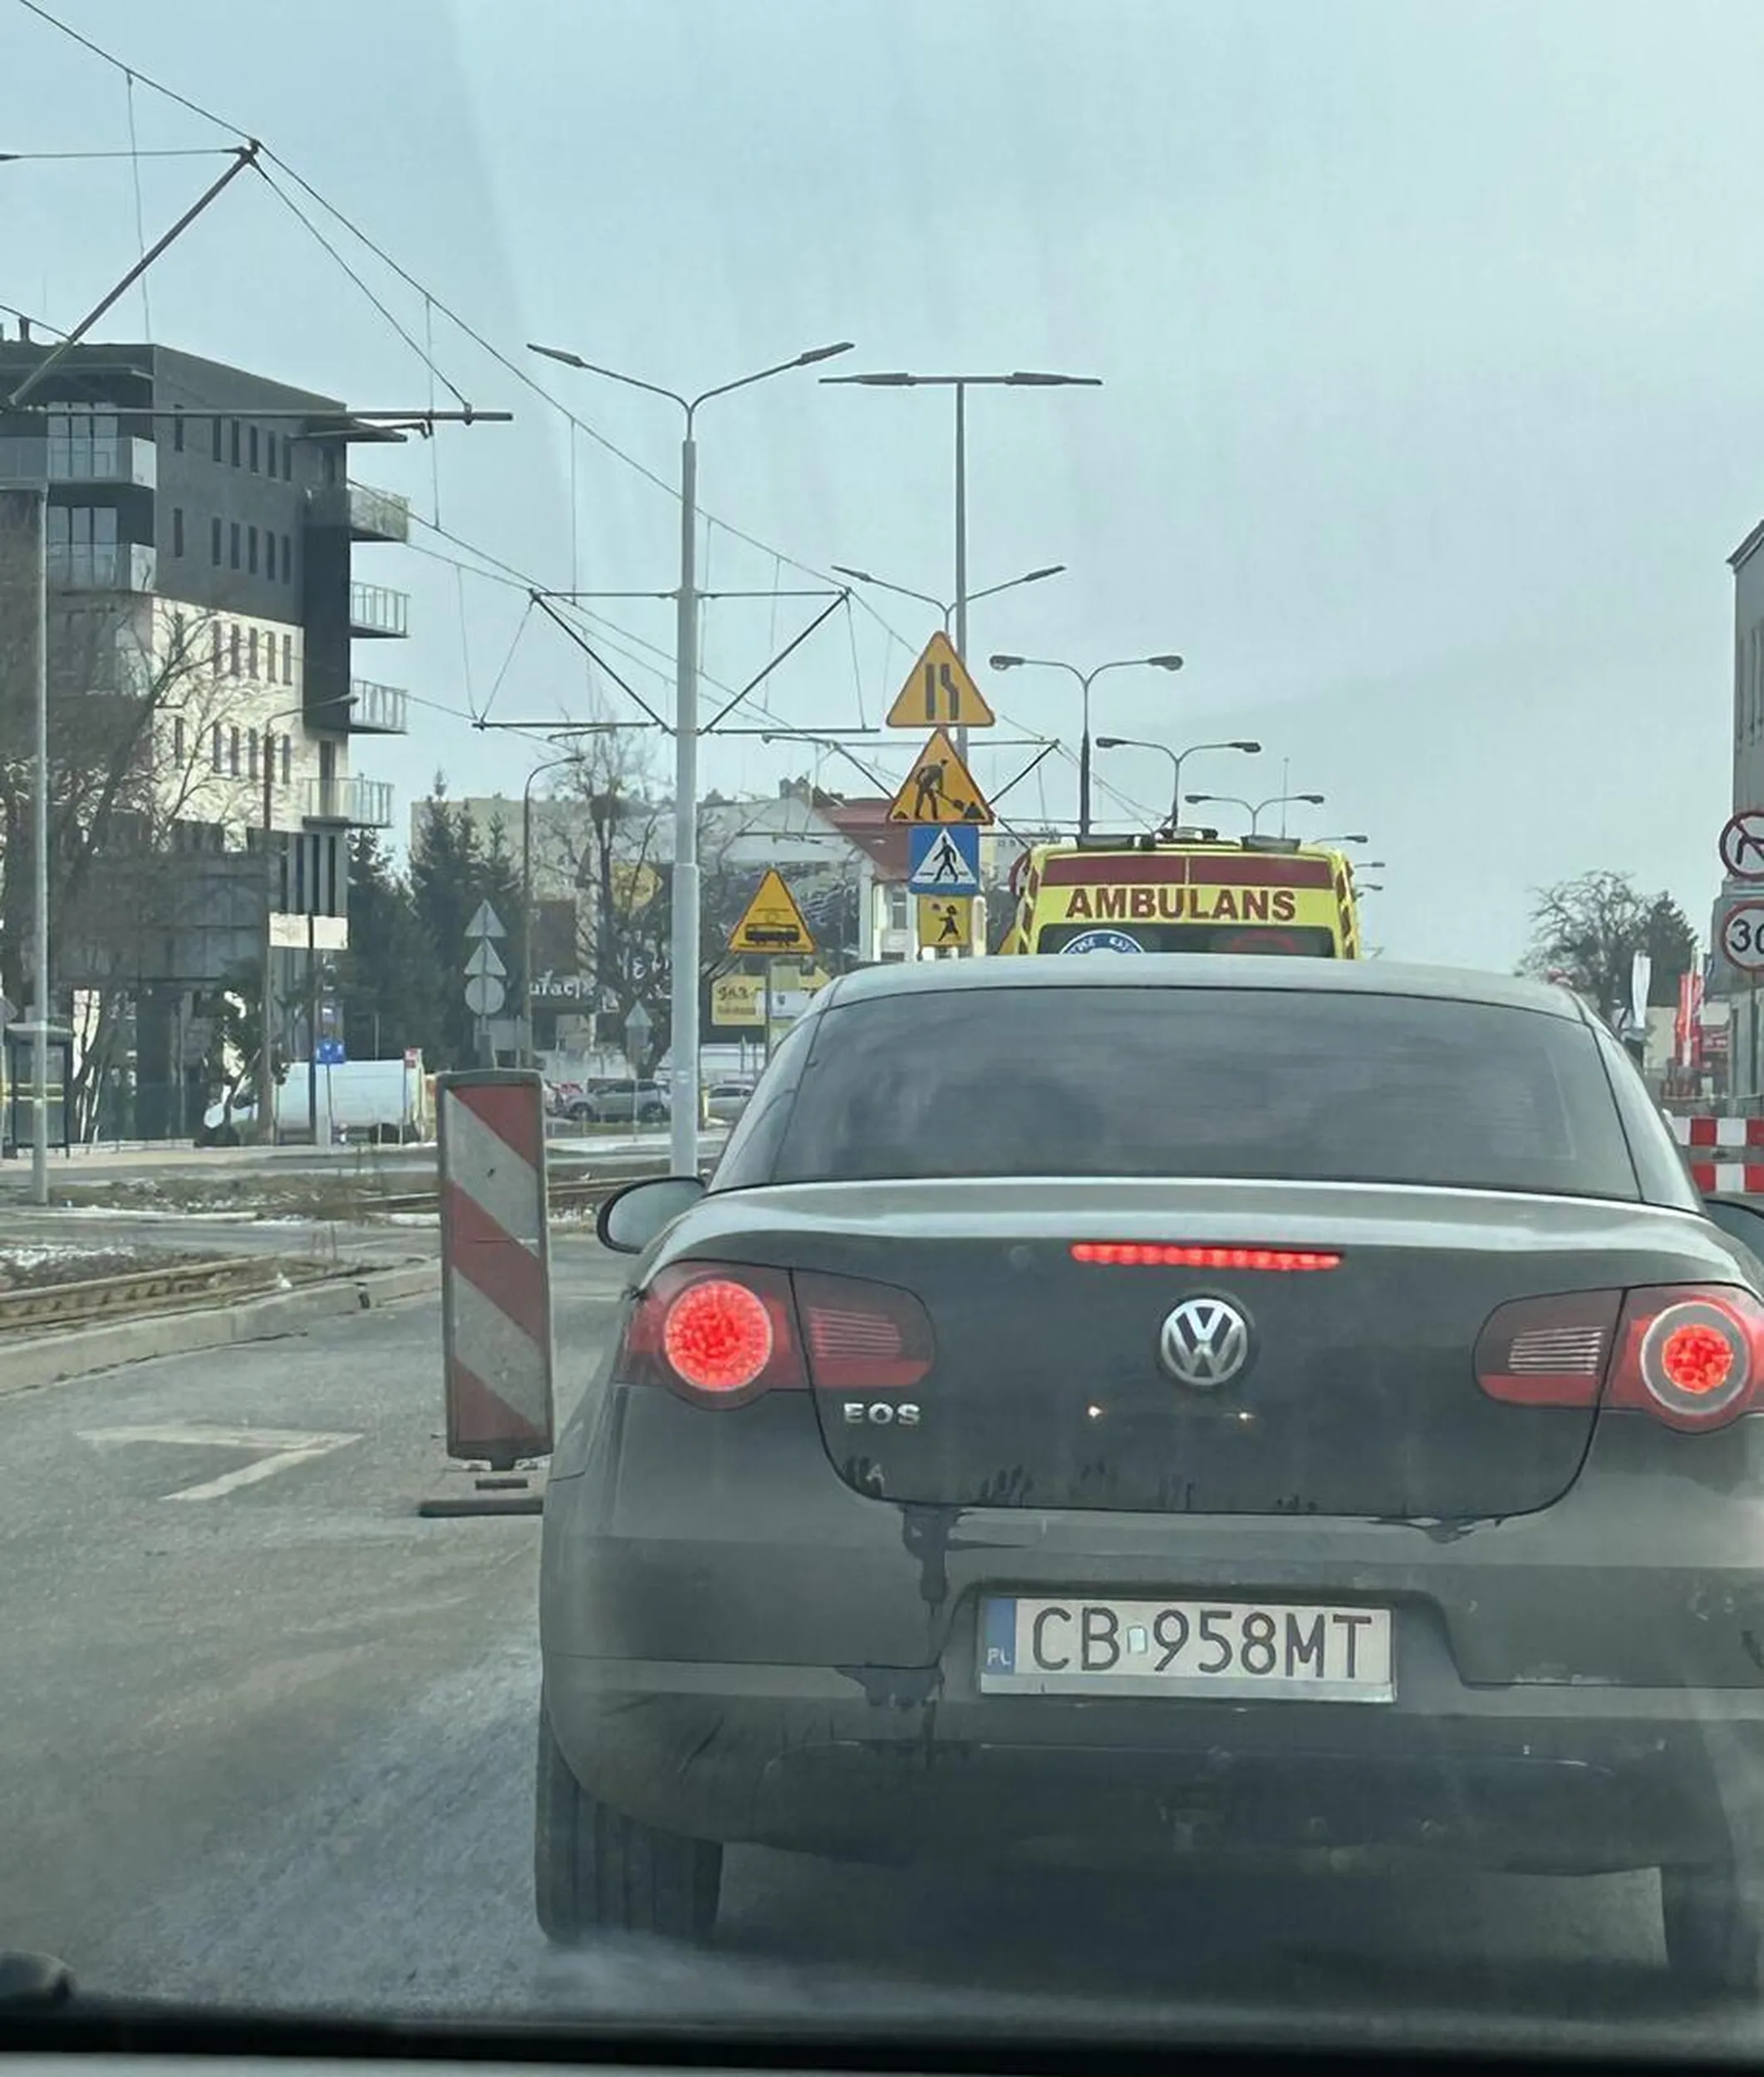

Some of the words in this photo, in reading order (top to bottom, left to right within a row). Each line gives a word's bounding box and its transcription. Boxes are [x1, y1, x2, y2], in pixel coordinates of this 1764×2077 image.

[1065, 886, 1296, 922] AMBULANS
[843, 1402, 921, 1425] EOS
[986, 1647, 1011, 1667] PL
